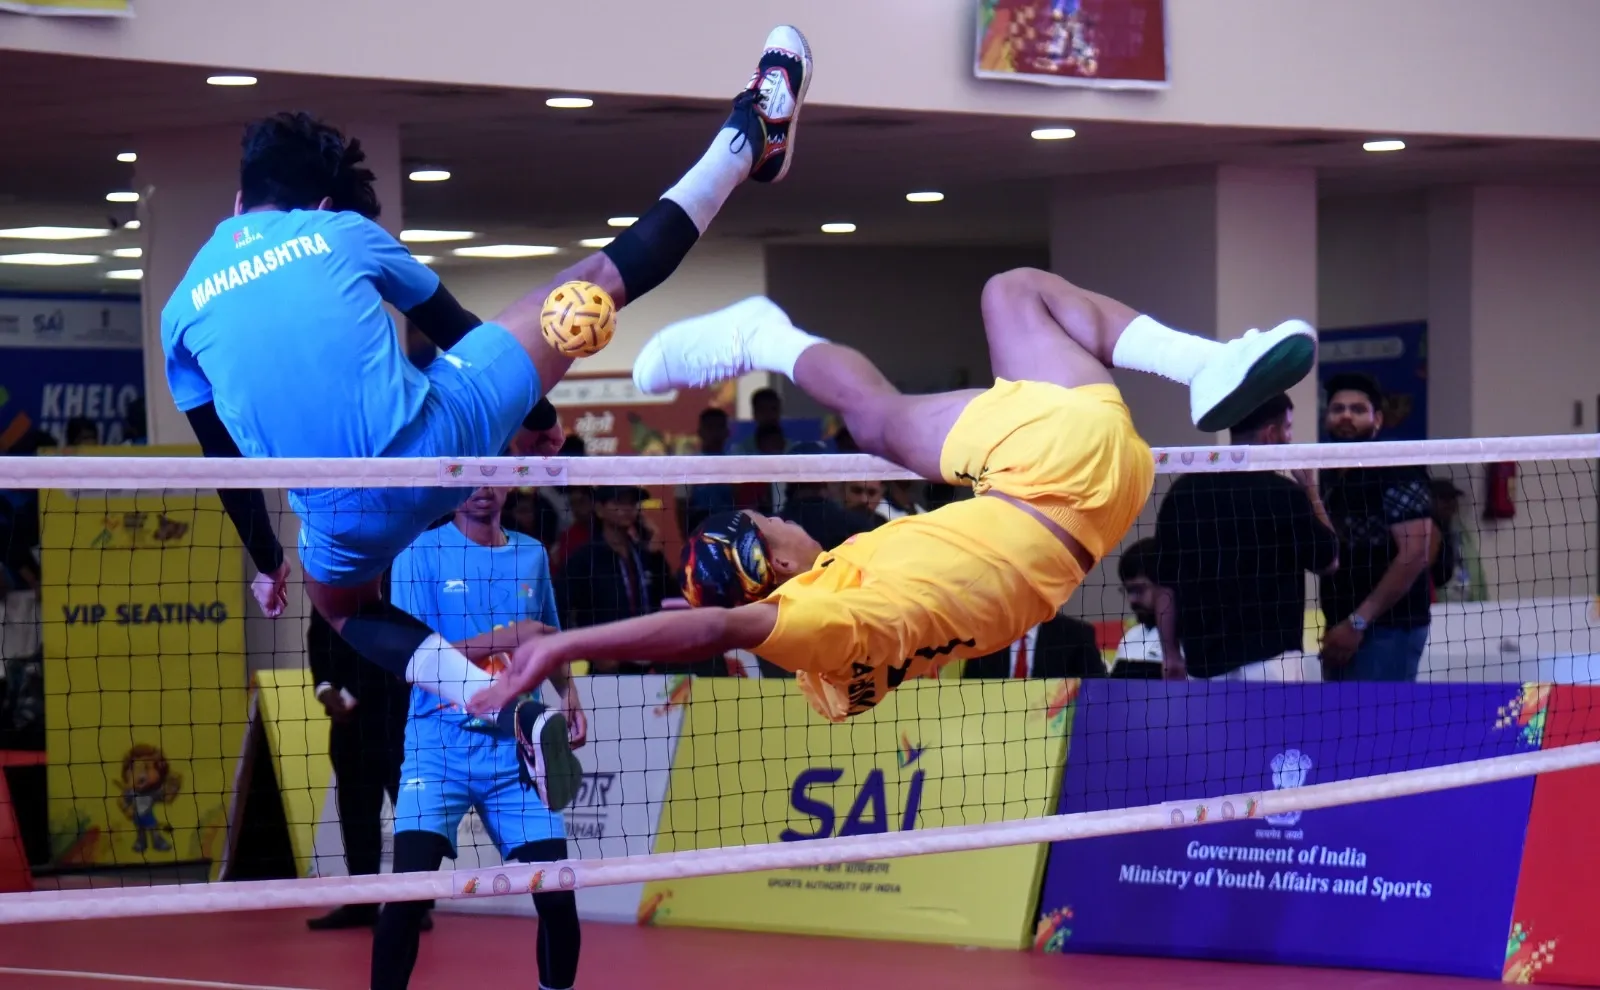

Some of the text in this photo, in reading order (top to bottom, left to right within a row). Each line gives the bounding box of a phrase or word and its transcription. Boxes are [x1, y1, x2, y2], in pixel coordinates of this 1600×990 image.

[235, 232, 264, 249] INDIA
[191, 232, 332, 311] MAHARASHTRA
[63, 601, 228, 625] VIP SEATING
[1187, 840, 1366, 868] Government of India
[768, 878, 901, 893] SPORTS AUTHORITY OF INDIA
[1119, 864, 1432, 901] Ministry of Youth Affairs and Sports
